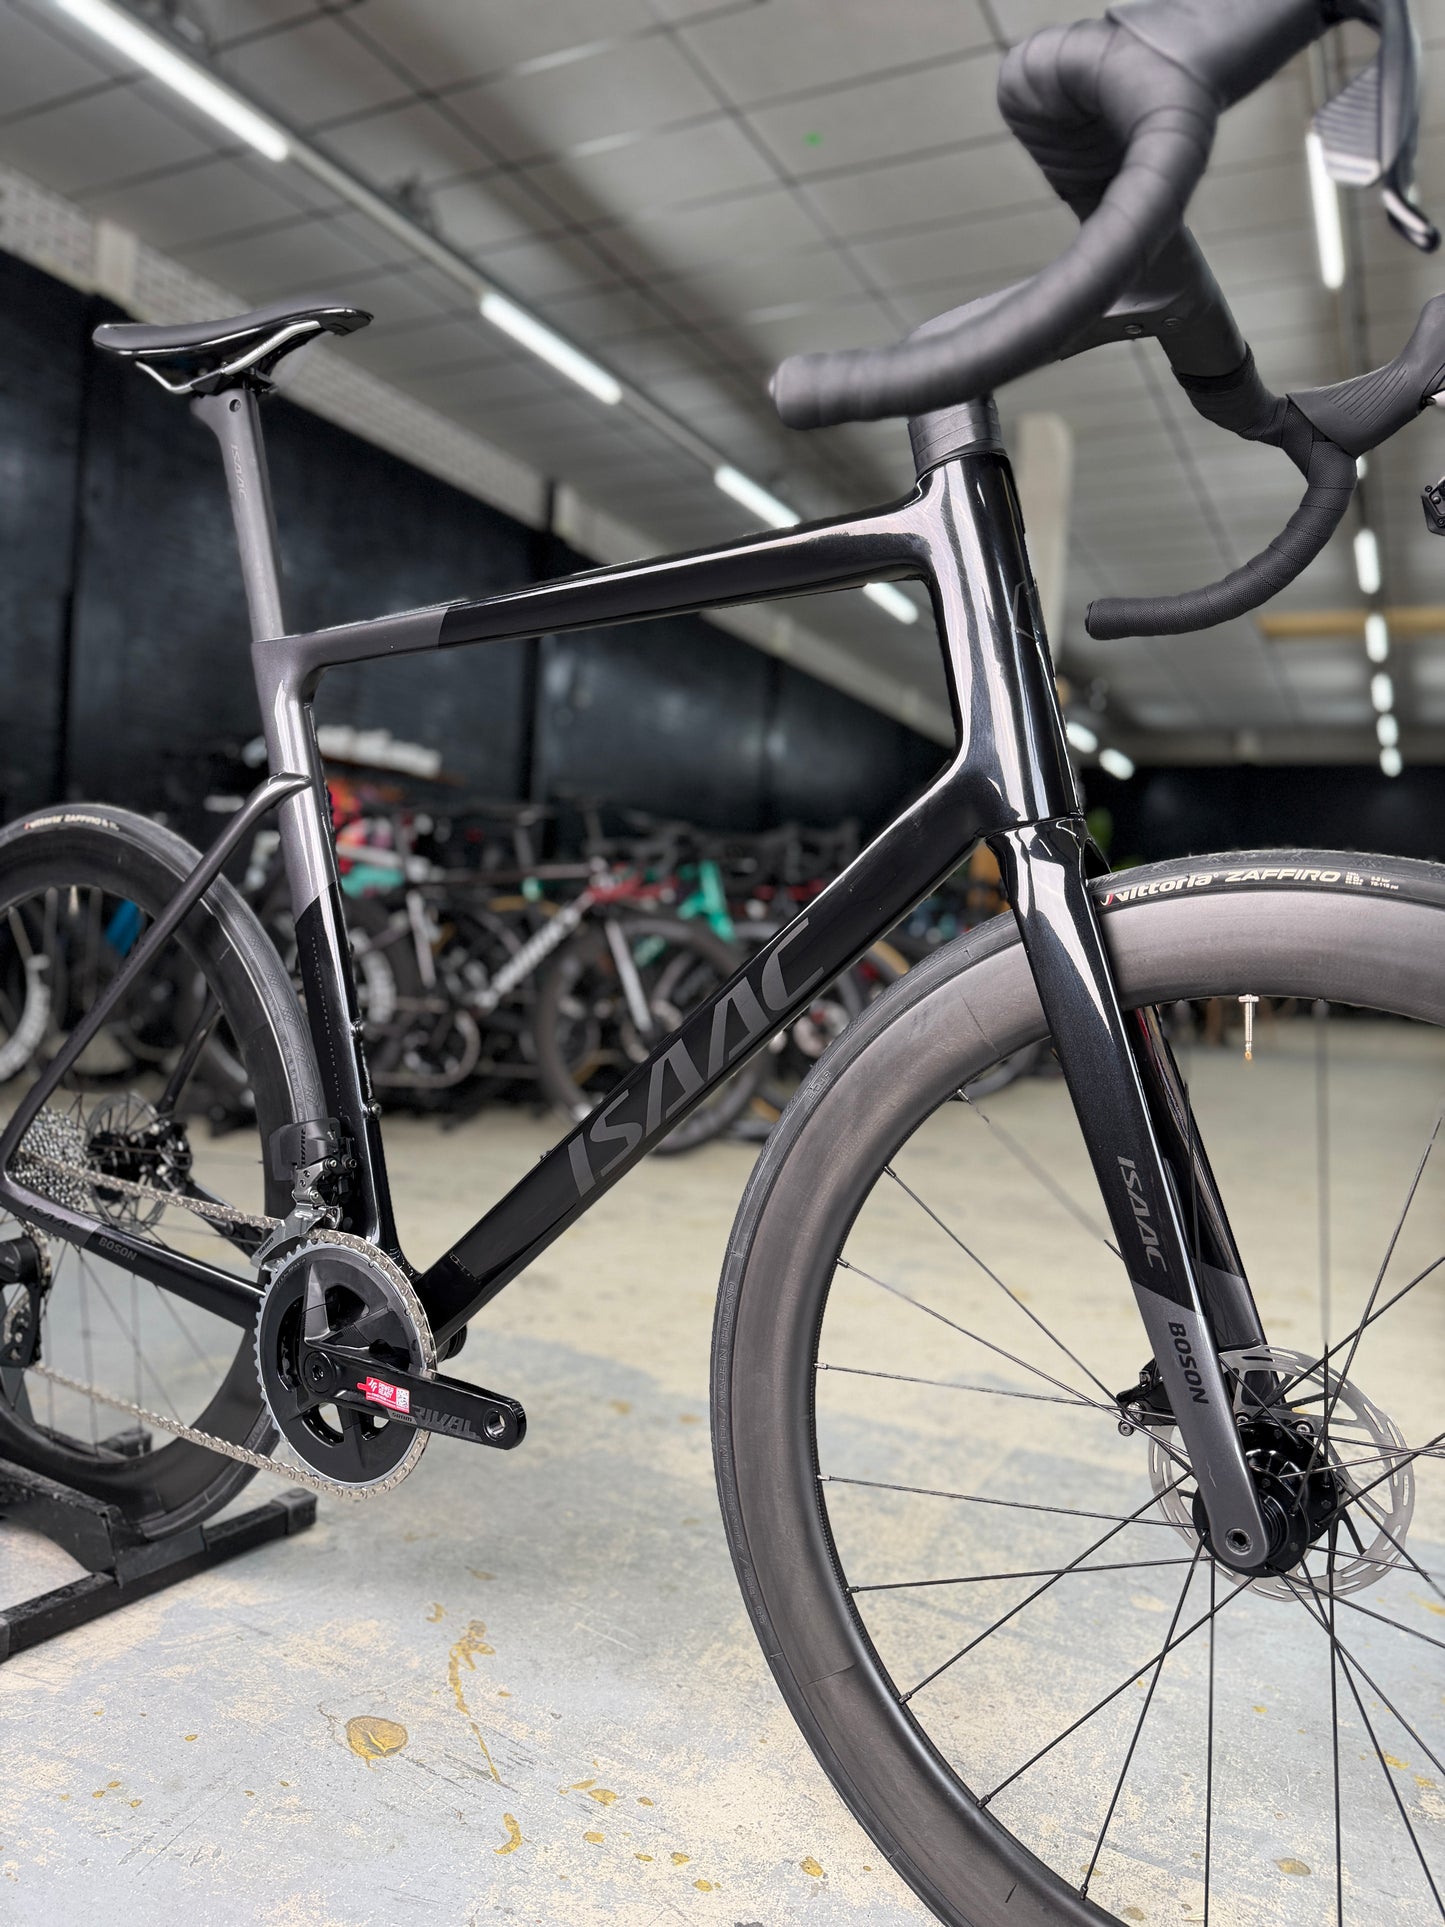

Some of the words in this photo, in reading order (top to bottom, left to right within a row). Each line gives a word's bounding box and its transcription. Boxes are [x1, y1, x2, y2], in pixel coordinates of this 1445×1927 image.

[230, 443, 247, 501] ISAAC
[1225, 868, 1341, 883] ZAFFIRO
[568, 917, 824, 1197] ISAAC
[1117, 1155, 1168, 1273] ISAAC
[98, 1236, 138, 1261] BOSON
[1168, 1321, 1210, 1405] BOSON
[391, 1411, 413, 1422] SRAM
[411, 1404, 483, 1440] RIVAL
